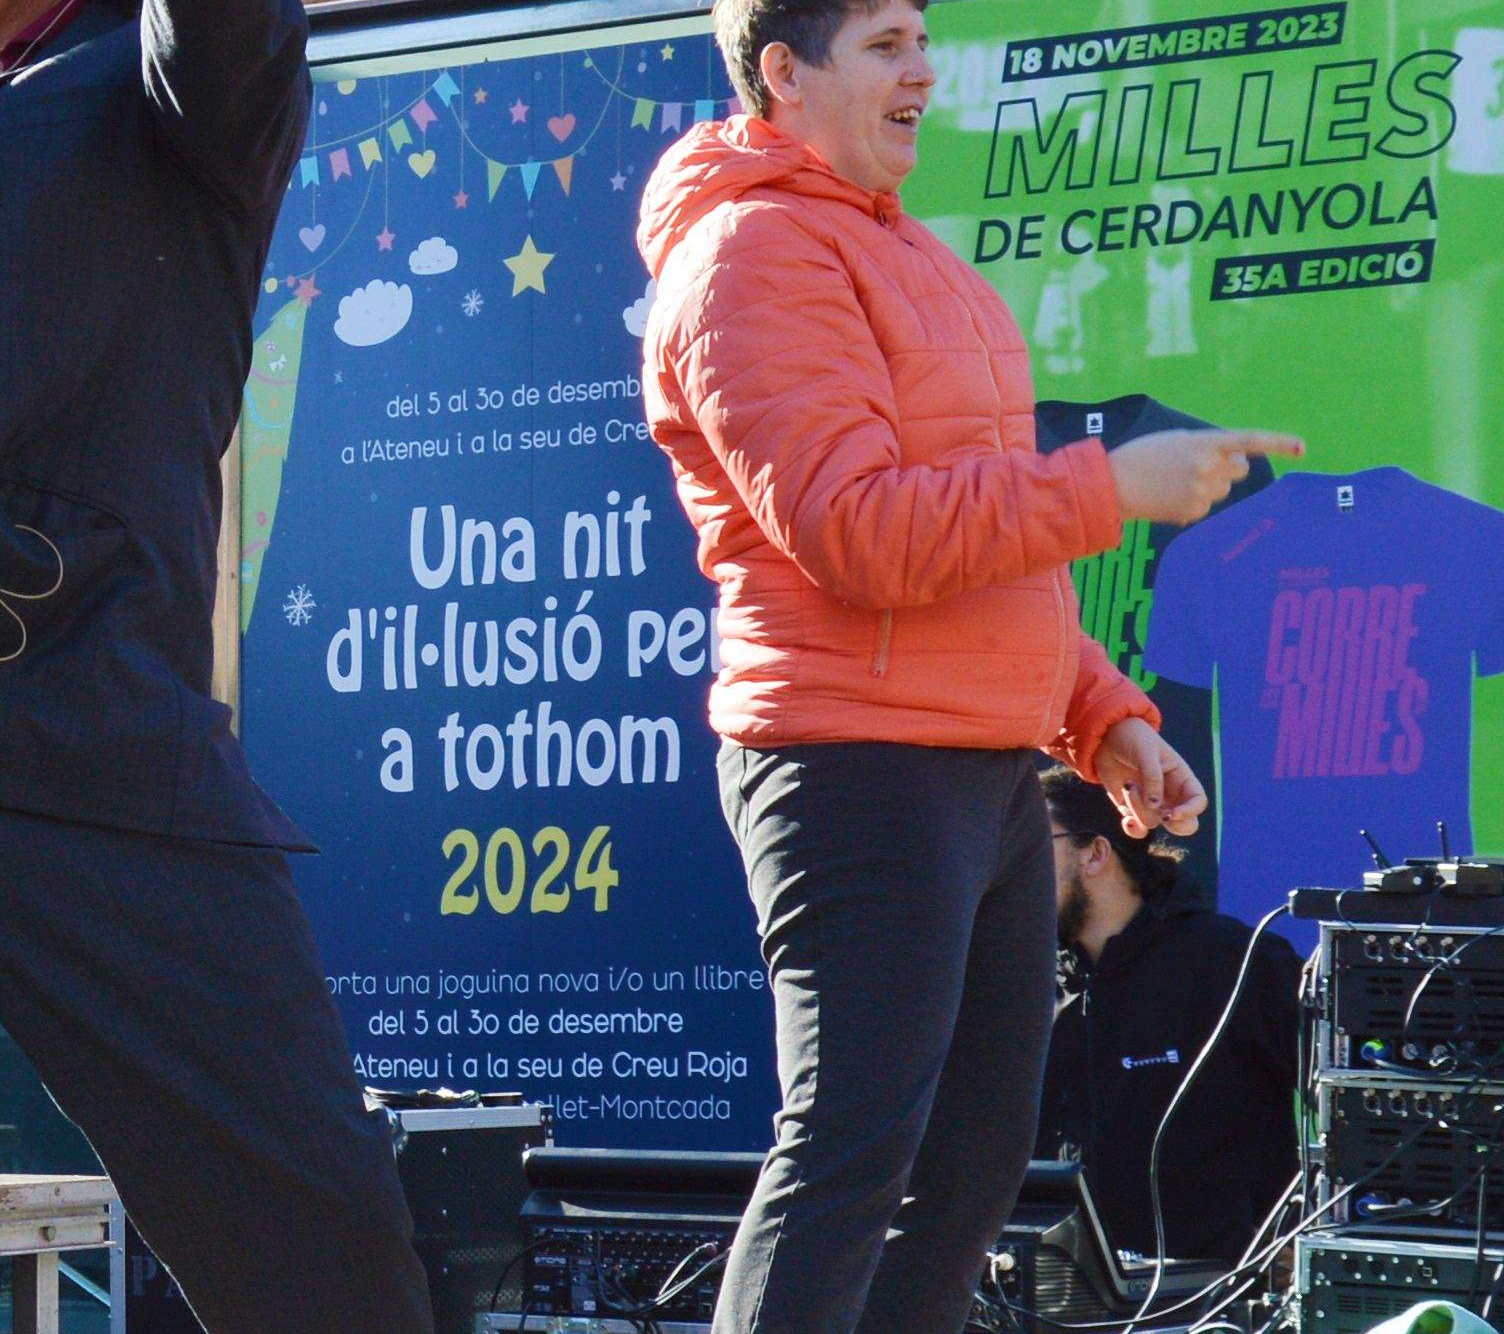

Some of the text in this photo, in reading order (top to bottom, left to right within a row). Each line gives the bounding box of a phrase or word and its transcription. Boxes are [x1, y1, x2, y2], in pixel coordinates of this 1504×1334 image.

[1010, 11, 1339, 75] 18 NOVEMBRE 2023
[983, 49, 1463, 199] MILLES
[974, 176, 1438, 264] DE CERDANYOLA
[1222, 244, 1423, 294] 35A EDICIÓ
[387, 374, 643, 418] del 5 al 30 de desemb
[341, 419, 649, 464] a l'Ateneu i a la seu de Cre
[410, 490, 652, 590] Una nit
[326, 589, 602, 693] d'il·lusió
[380, 701, 680, 793] a tothom
[440, 825, 619, 915] 2024
[385, 975, 430, 995] una
[436, 969, 529, 999] joguina
[539, 973, 599, 993] nova
[610, 966, 643, 992] i/o
[653, 971, 684, 991] un
[695, 965, 765, 990] llibre
[368, 1007, 684, 1035] del 5 al 30 de desembre
[447, 1052, 454, 1078] i
[463, 1057, 478, 1078] a
[487, 1053, 508, 1078] la
[517, 1057, 562, 1078] seu
[572, 1052, 603, 1078] de
[612, 1051, 678, 1078] Creu
[688, 1051, 747, 1083] Roja
